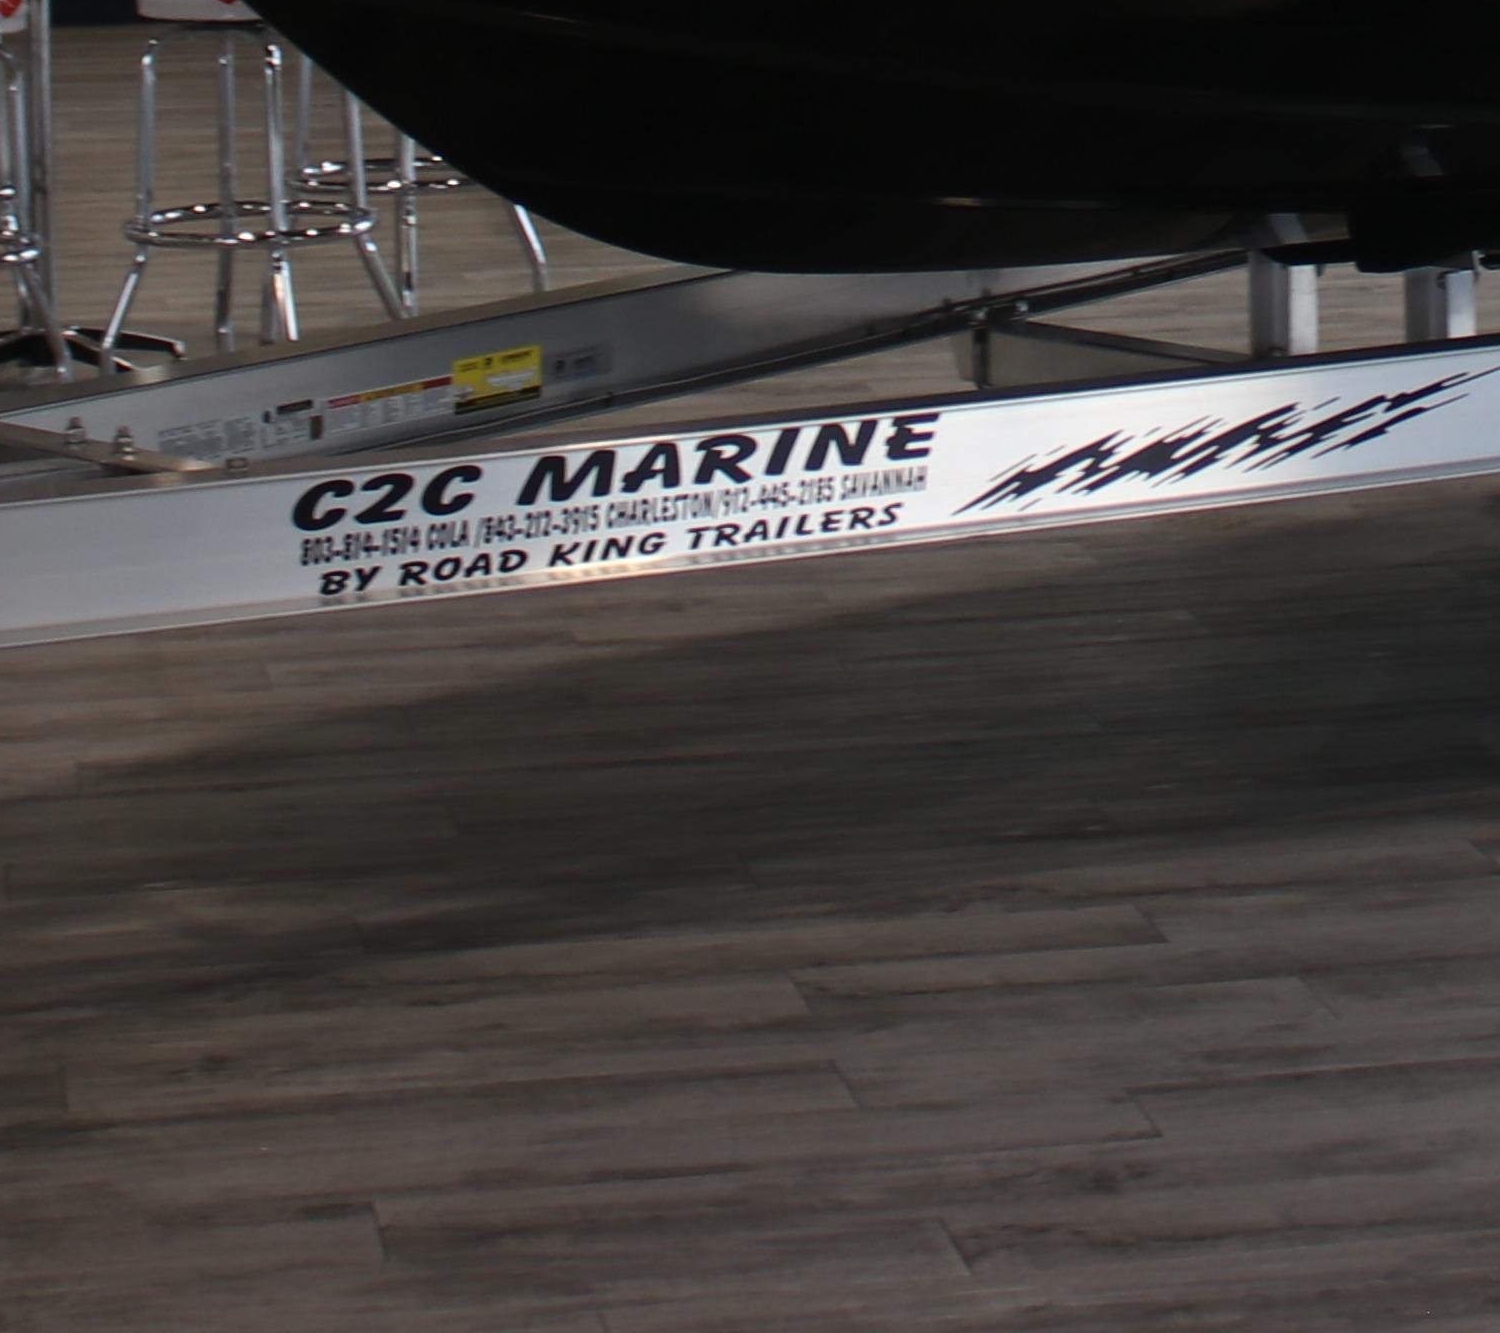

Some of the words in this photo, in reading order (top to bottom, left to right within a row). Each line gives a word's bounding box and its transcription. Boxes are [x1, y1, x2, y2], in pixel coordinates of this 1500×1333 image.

[292, 464, 483, 531] C2C
[516, 412, 940, 507] MARINE
[840, 465, 929, 502] SAVANNAH
[319, 565, 382, 596] BY
[399, 548, 528, 586] ROAD
[550, 532, 668, 568] KING
[687, 501, 904, 551] TRAILERS
